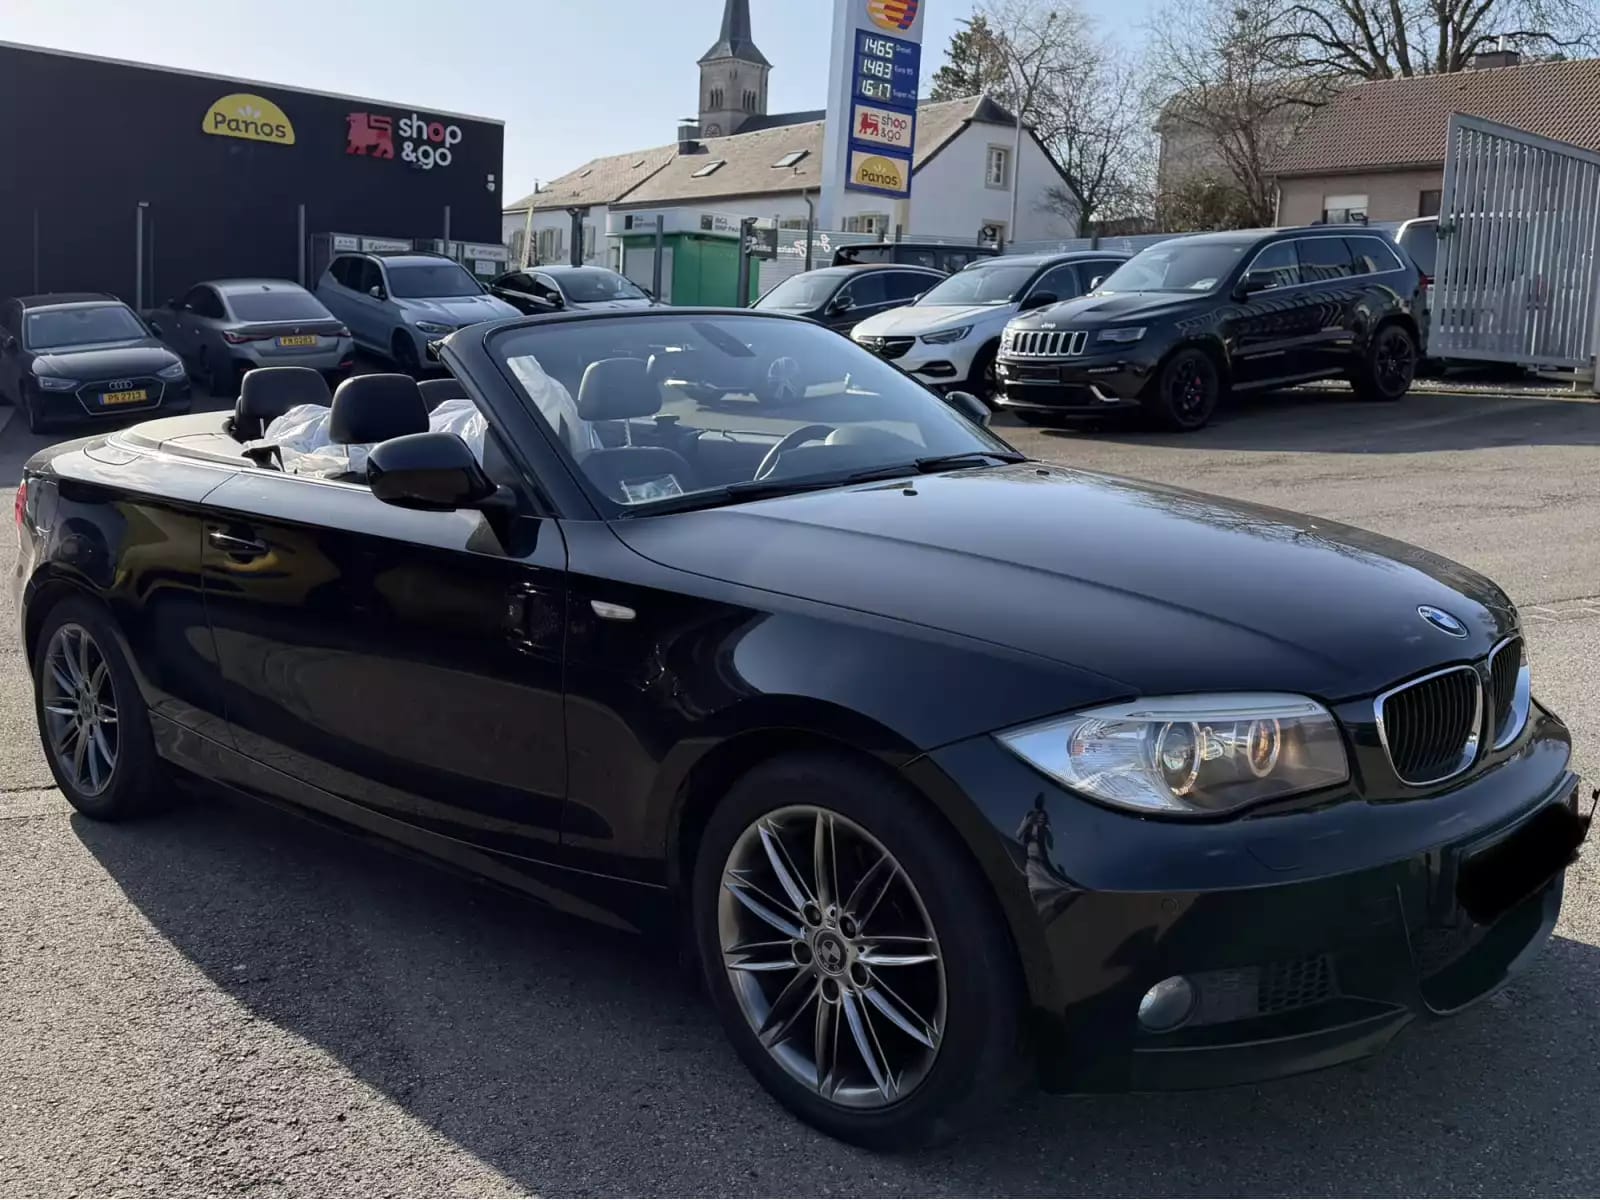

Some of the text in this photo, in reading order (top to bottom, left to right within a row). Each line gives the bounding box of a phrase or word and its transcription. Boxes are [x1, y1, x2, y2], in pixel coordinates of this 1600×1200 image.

[213, 111, 287, 139] Panos
[398, 113, 463, 148] shop
[881, 113, 907, 131] shop
[881, 127, 902, 142] &go
[401, 140, 453, 170] &go
[861, 168, 898, 187] Panos
